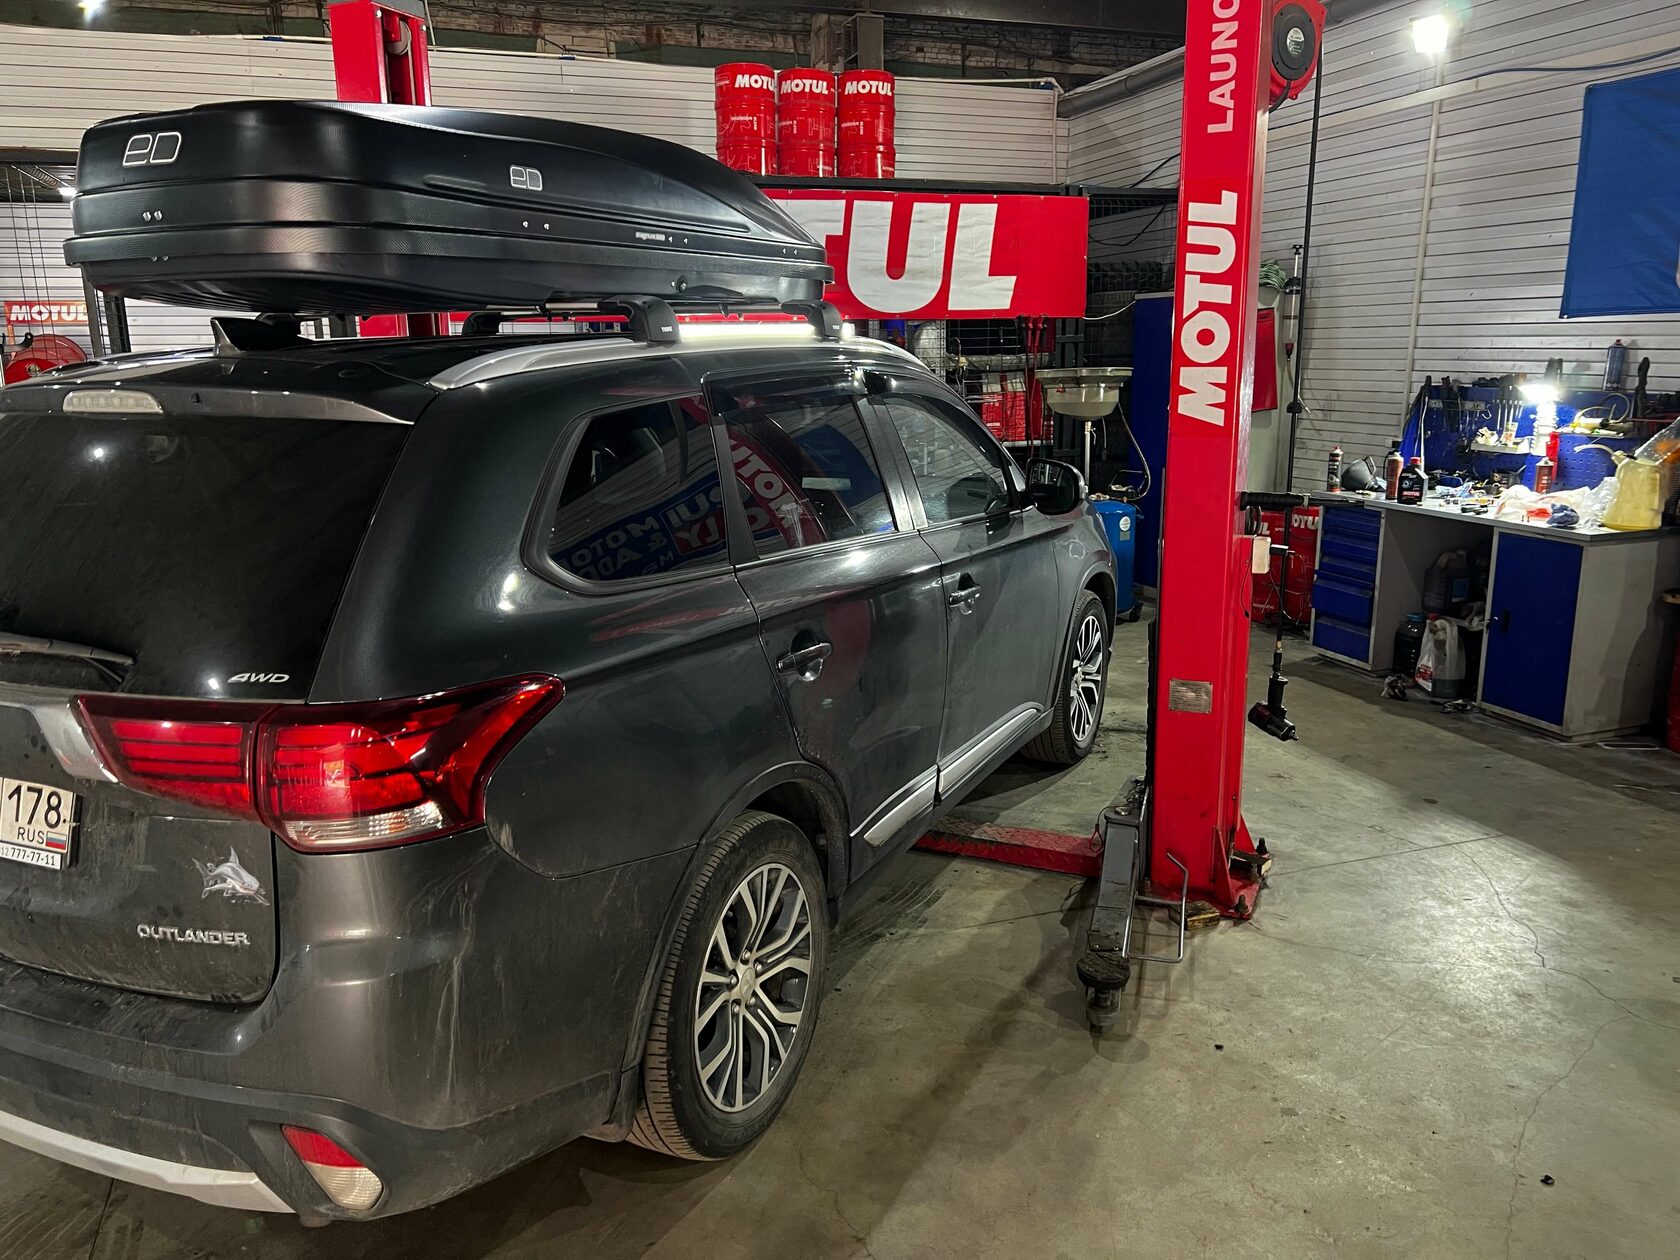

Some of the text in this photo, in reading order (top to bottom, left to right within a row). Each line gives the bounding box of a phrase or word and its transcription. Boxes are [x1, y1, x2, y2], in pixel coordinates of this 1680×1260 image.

[780, 79, 829, 95] MOTUL
[844, 80, 893, 97] MOTUL
[10, 304, 88, 321] MOTUL
[1177, 189, 1238, 427] MOTUL
[1291, 512, 1319, 530] OTU
[227, 672, 290, 683] 4WD
[8, 785, 62, 829] 178
[17, 826, 45, 845] RUS
[11, 847, 56, 866] 777-77-11
[137, 923, 251, 945] OUTLANDER
